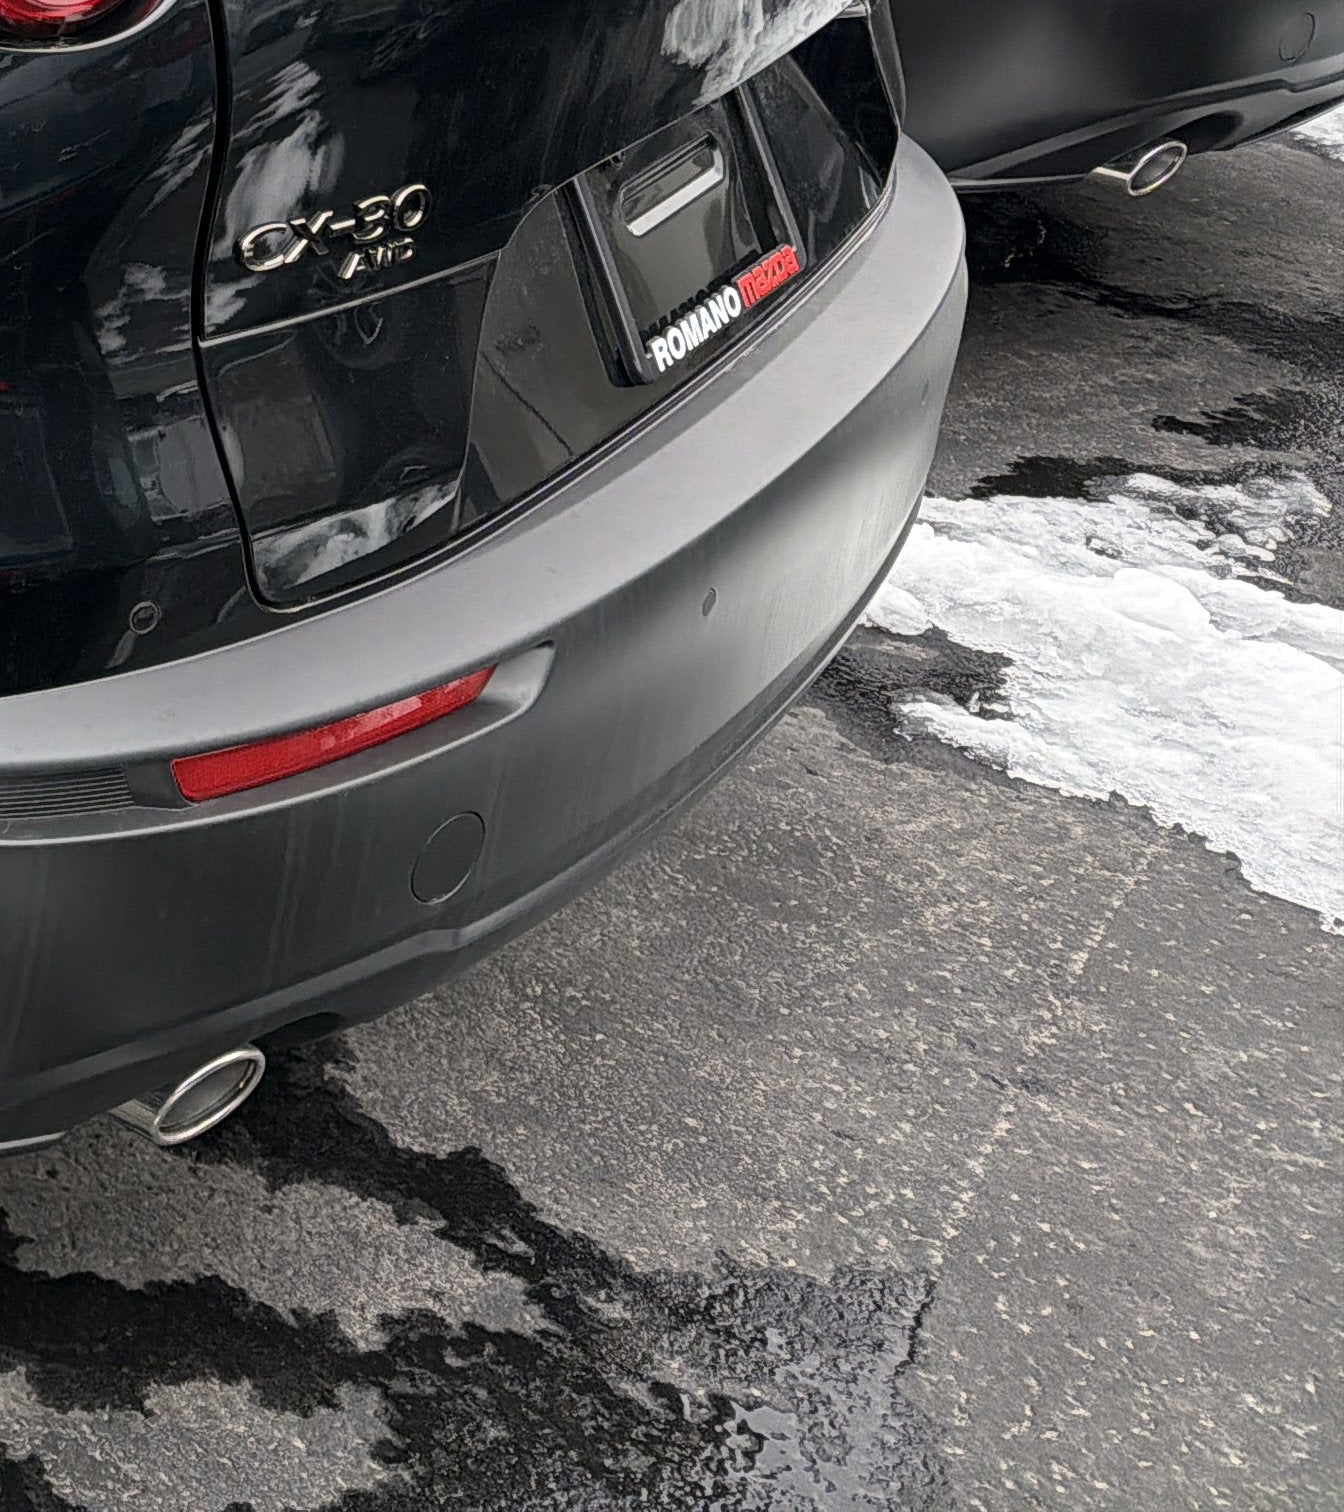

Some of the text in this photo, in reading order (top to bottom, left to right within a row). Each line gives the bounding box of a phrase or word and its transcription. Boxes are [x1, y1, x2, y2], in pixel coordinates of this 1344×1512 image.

[233, 184, 432, 272] CX-30
[337, 237, 415, 279] AWD
[649, 285, 742, 373] ROMANO
